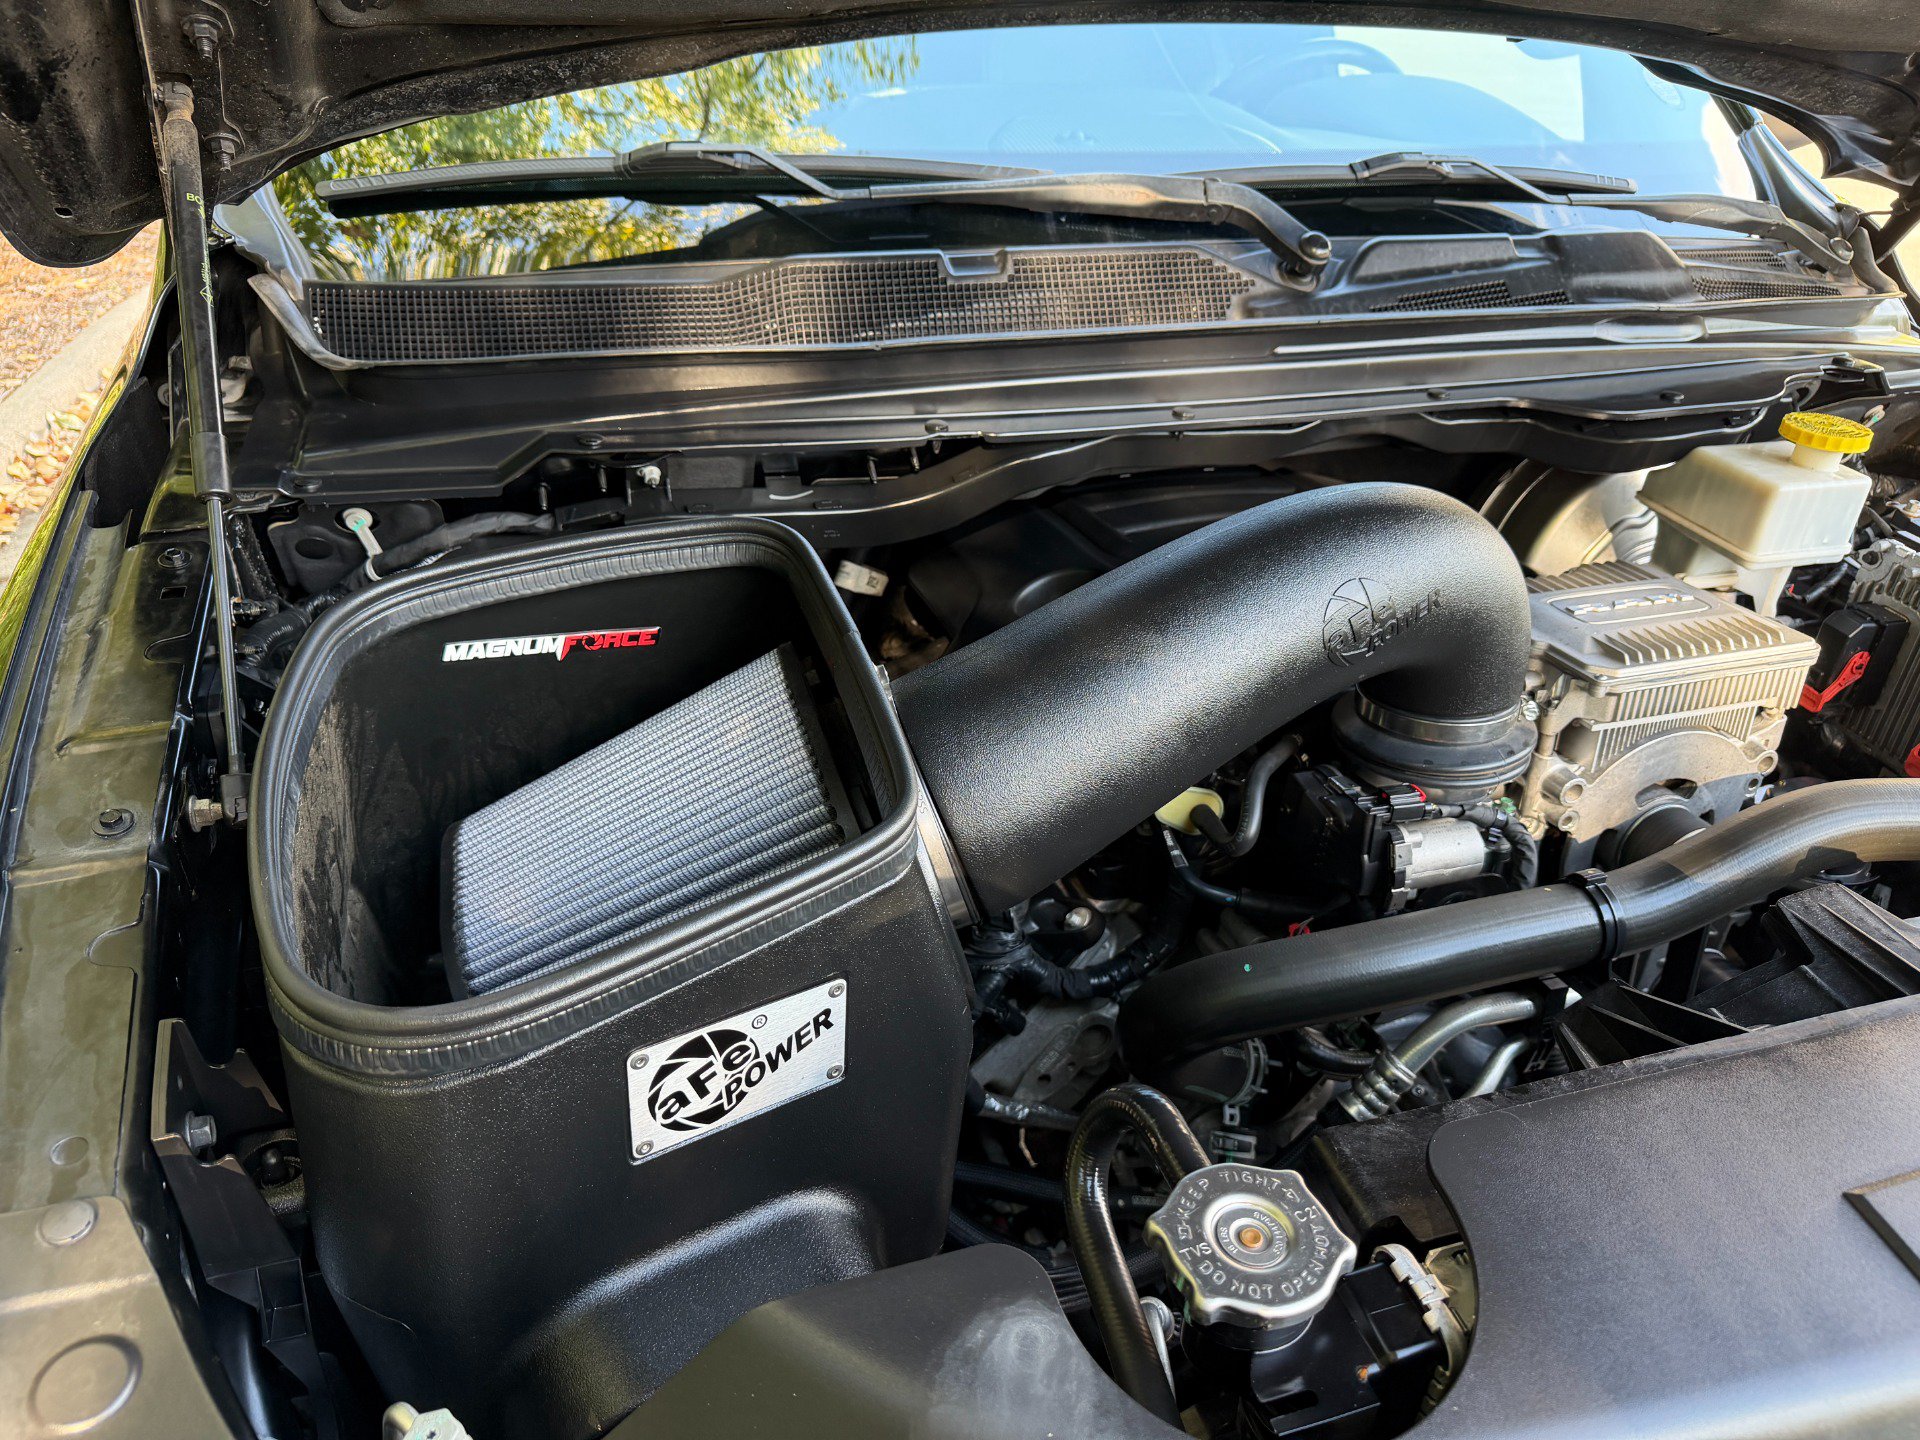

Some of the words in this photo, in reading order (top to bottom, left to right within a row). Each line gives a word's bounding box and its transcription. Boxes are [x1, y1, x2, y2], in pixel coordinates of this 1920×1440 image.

[656, 1043, 752, 1122] aFe
[723, 1007, 834, 1108] POWER
[1176, 1178, 1209, 1221] KEEP
[1218, 1170, 1281, 1190] TIGHT
[1179, 1241, 1212, 1261] TVS
[1199, 1260, 1226, 1286] DO
[1230, 1278, 1274, 1300] NOT
[1281, 1257, 1325, 1297] OPEN
